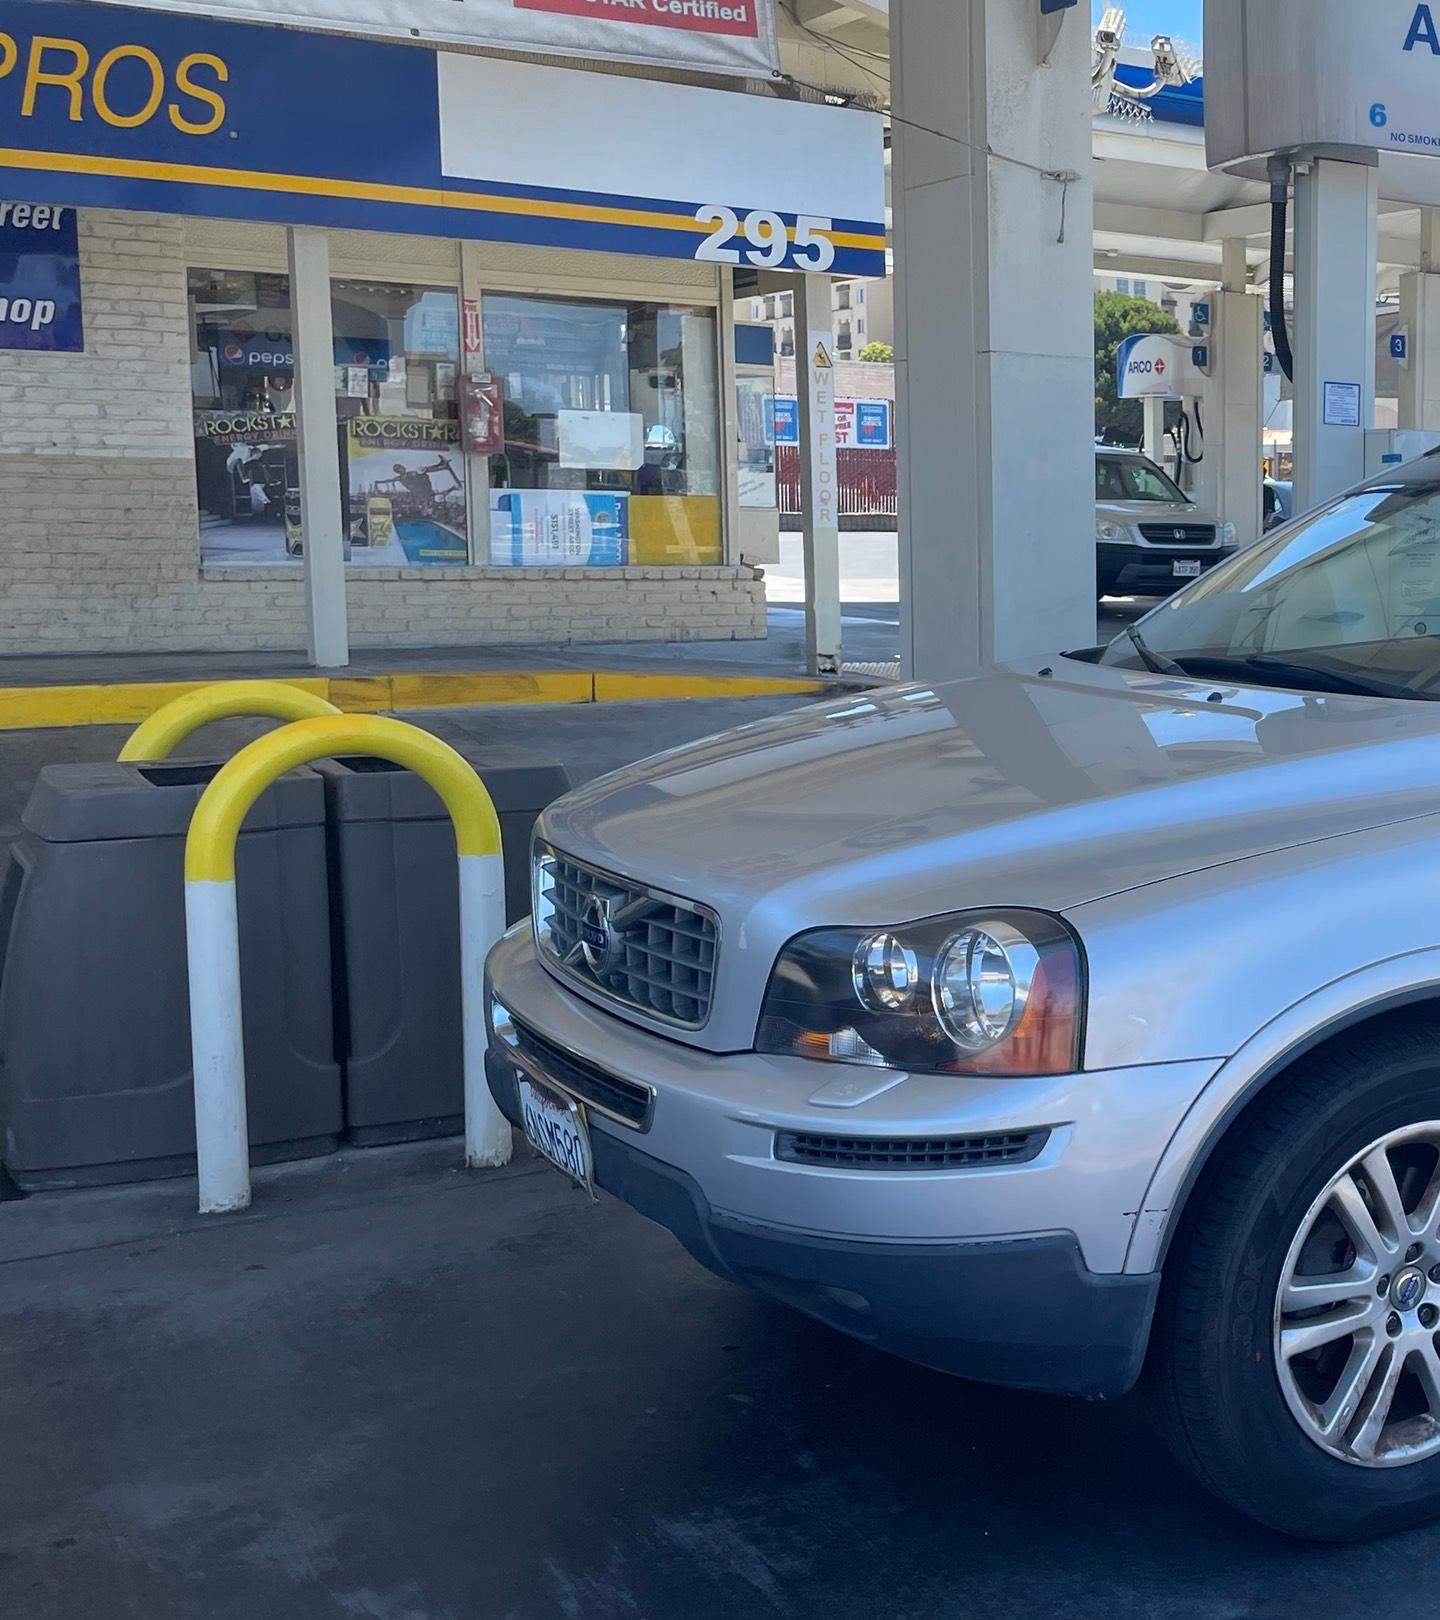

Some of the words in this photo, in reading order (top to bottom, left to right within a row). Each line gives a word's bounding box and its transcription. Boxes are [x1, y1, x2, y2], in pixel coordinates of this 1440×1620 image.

[653, 0, 748, 23] Certified
[1368, 103, 1388, 128] 6
[1390, 132, 1406, 143] NO
[694, 205, 835, 272] 295
[1394, 339, 1403, 352] 3
[249, 351, 295, 368] peps
[1128, 359, 1152, 375] ARCO
